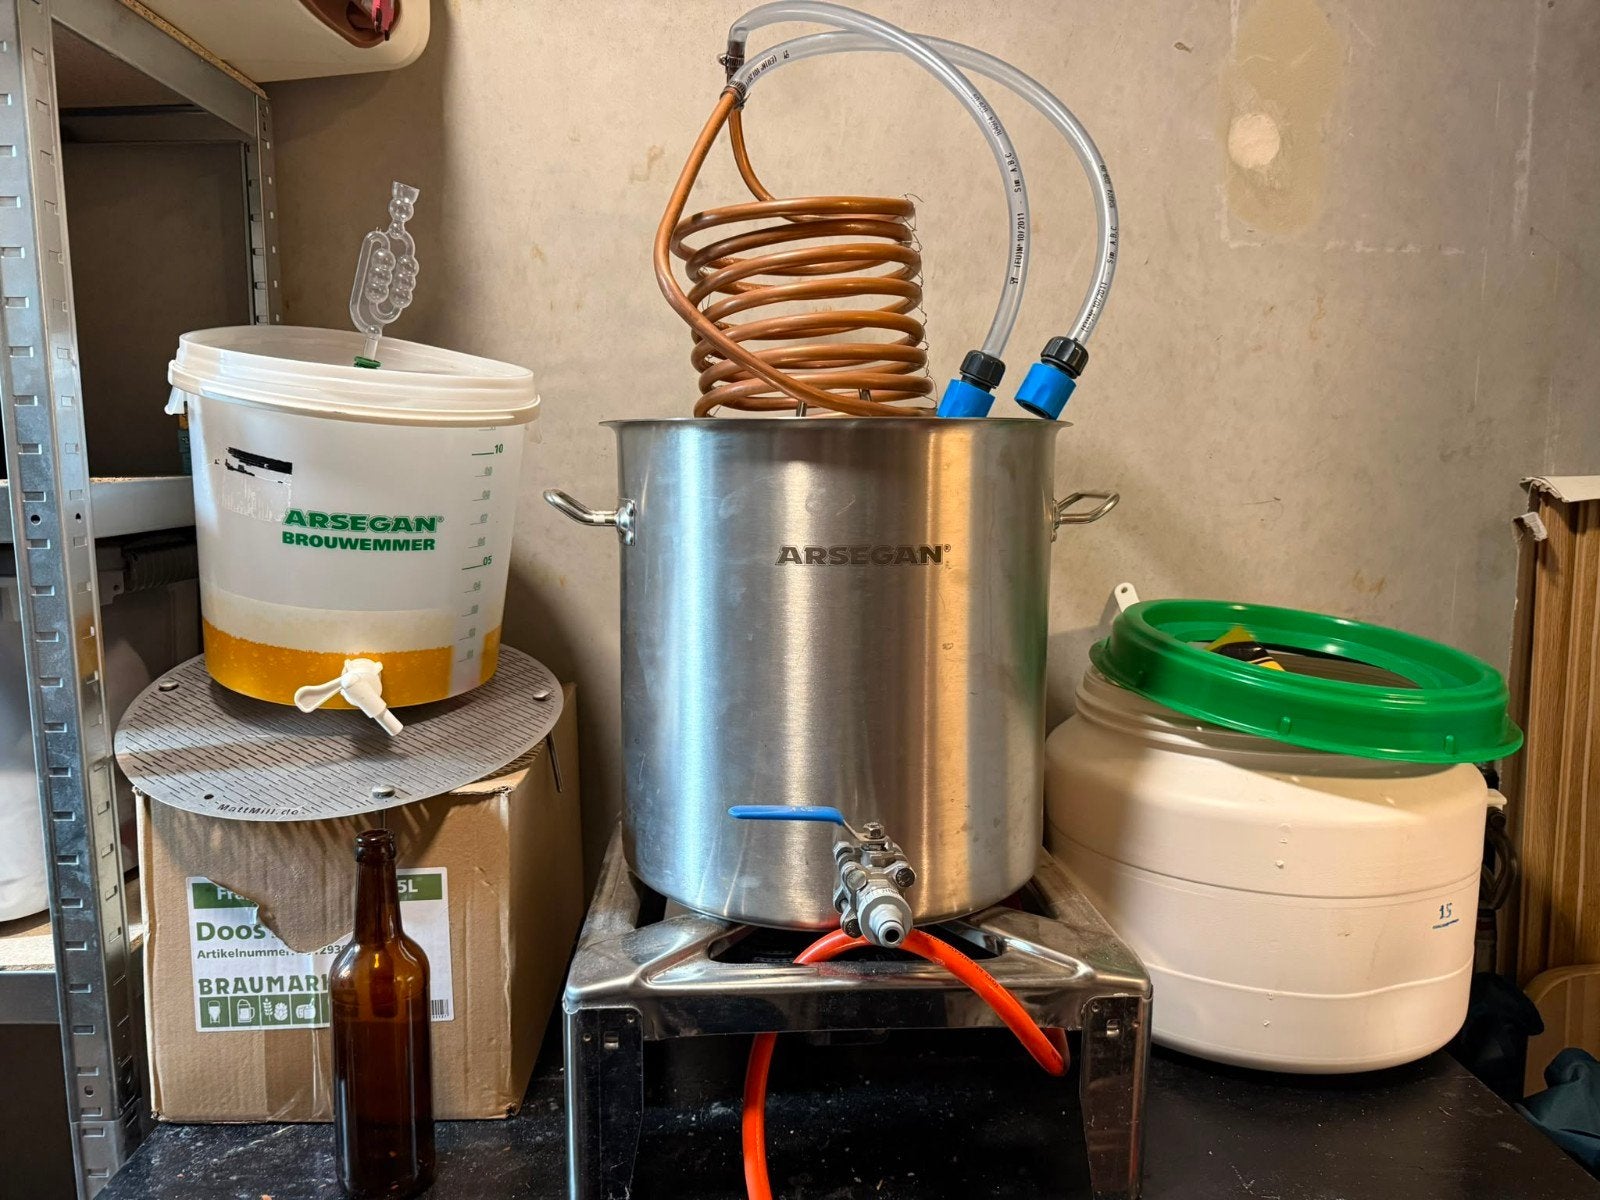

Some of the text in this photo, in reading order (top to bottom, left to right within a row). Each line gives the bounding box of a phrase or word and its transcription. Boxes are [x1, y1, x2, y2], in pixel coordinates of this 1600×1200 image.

[495, 443, 504, 454] 10
[282, 531, 436, 551] BROUWEMMER
[483, 555, 492, 566] 05
[1439, 902, 1452, 919] 15
[196, 921, 266, 941] Doos
